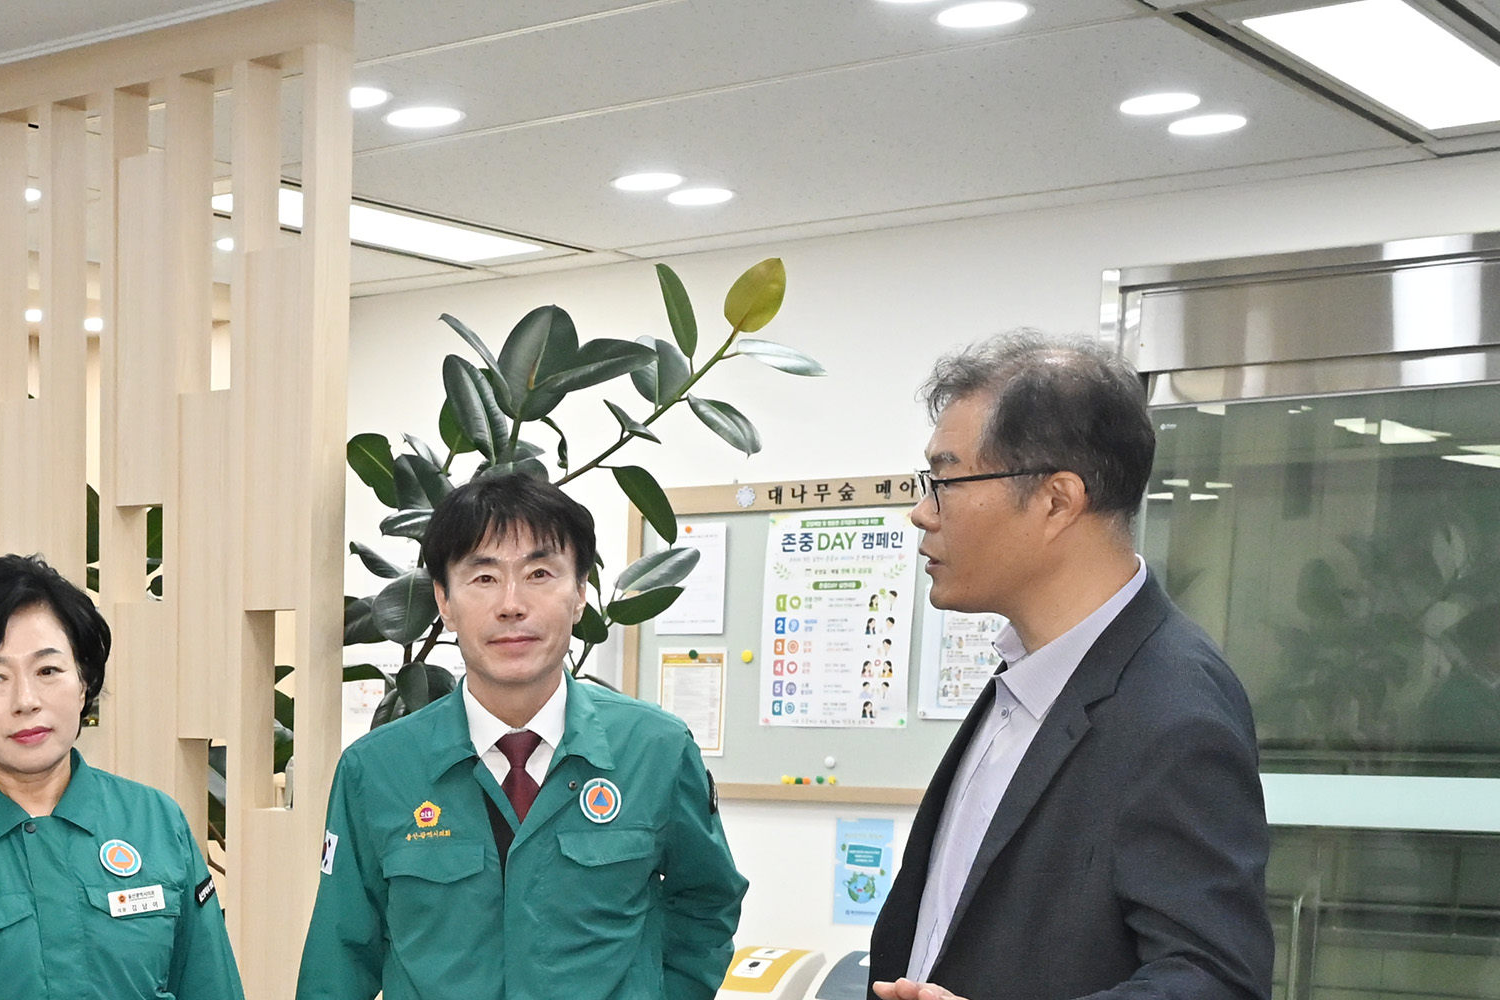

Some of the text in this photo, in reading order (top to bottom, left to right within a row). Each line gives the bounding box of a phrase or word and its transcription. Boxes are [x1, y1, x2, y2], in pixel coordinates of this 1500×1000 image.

[768, 482, 856, 505] 대나무숲
[781, 531, 904, 552] 존중 DAY 캠페인
[777, 620, 783, 631] 2
[776, 641, 783, 652] 3
[775, 662, 781, 673] 4
[775, 683, 781, 693] 5
[774, 703, 780, 713] 6
